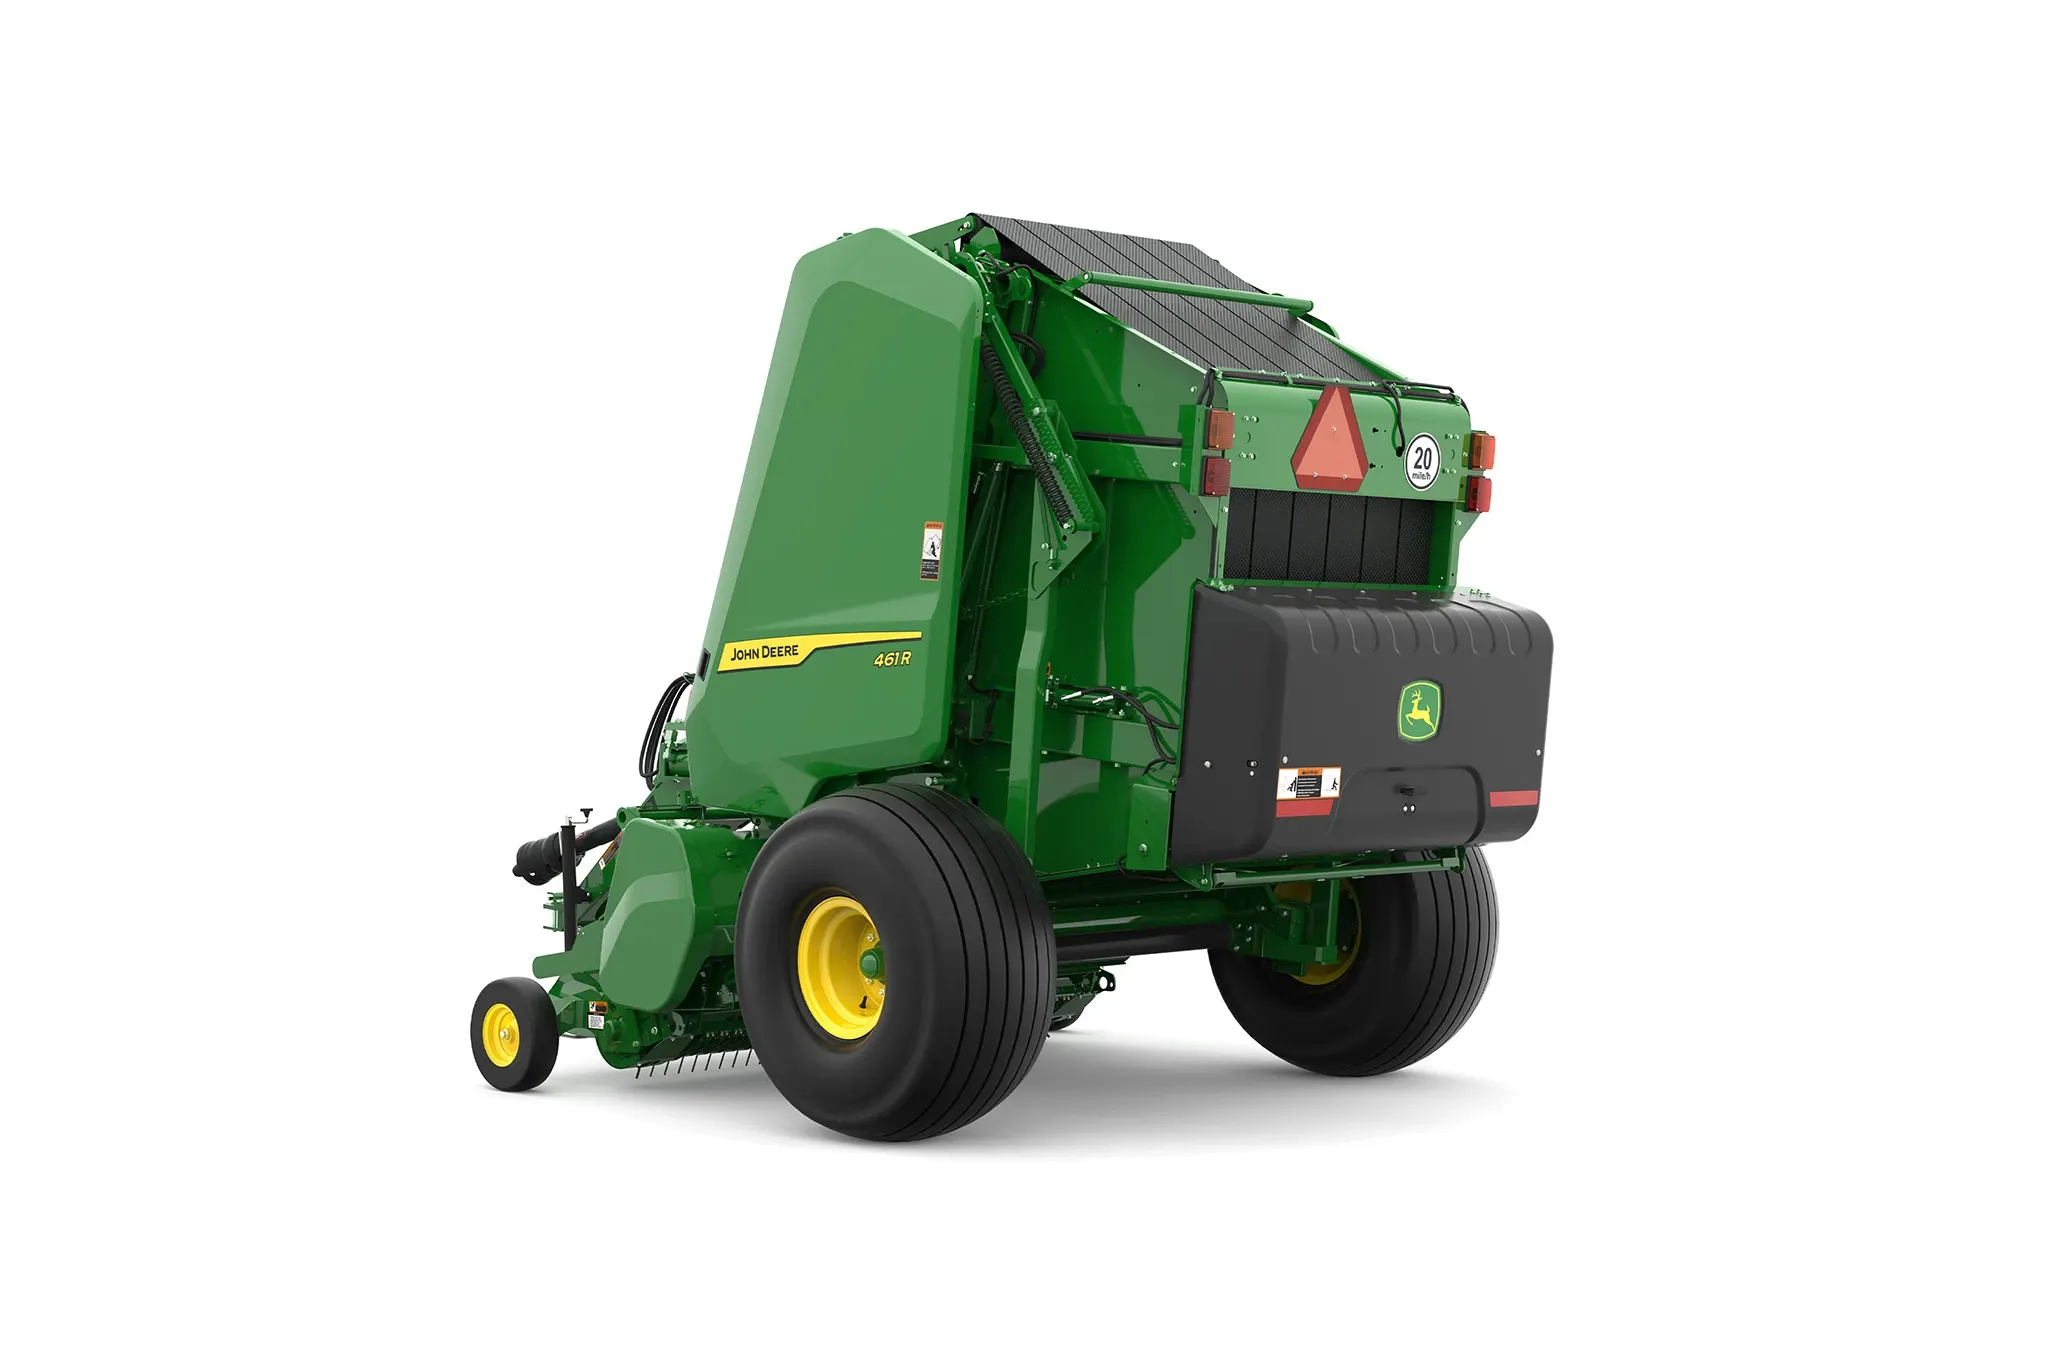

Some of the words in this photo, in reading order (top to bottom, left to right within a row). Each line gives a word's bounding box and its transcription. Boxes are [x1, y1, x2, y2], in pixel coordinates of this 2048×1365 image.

[1413, 446, 1432, 470] 20
[731, 648, 760, 661] JOHN
[762, 645, 799, 658] DEERE
[873, 651, 900, 667] 461
